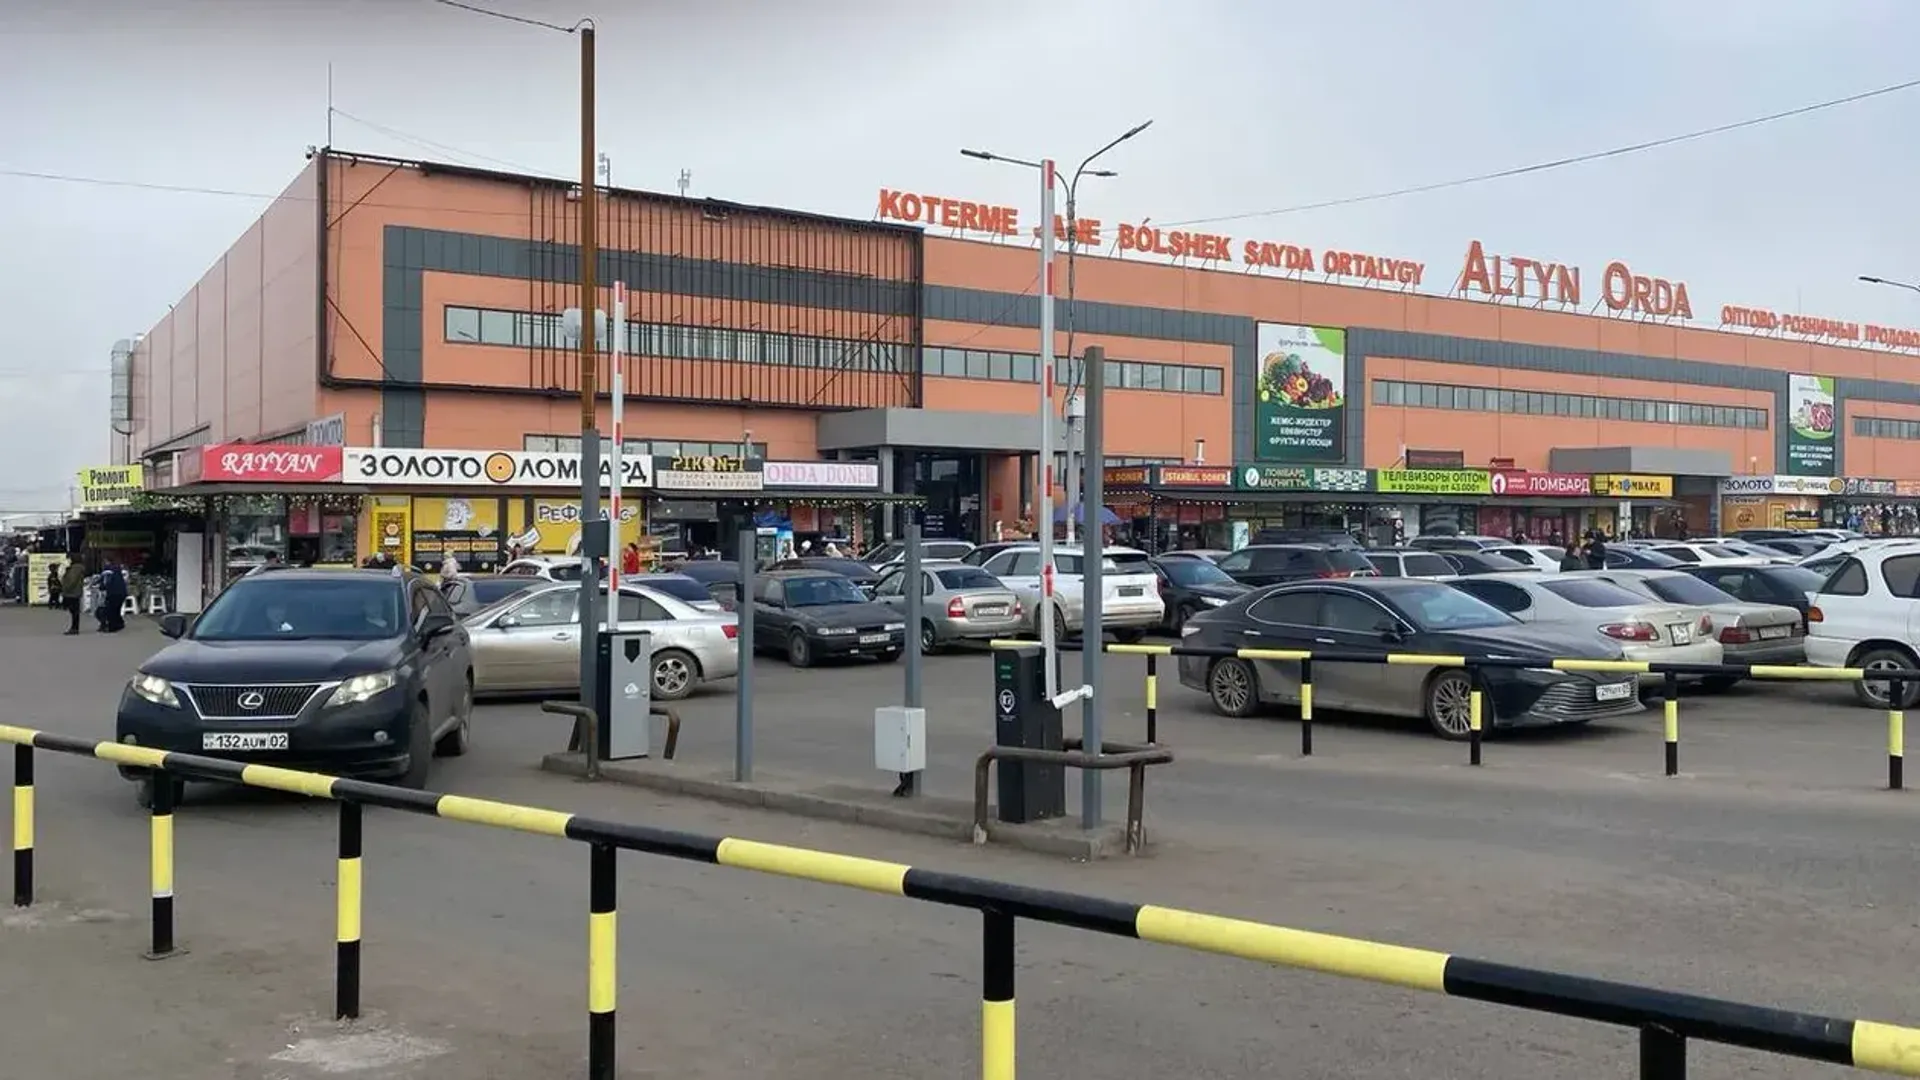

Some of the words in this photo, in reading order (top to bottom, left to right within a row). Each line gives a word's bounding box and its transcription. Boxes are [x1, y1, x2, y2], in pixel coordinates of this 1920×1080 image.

[880, 188, 1018, 236] KOTERME
[1118, 217, 1232, 261] BÓLSHEK
[1243, 240, 1315, 272] SAYDA
[1322, 250, 1425, 285] ORTALYGY
[1459, 240, 1580, 305] ALTYN
[1603, 261, 1693, 320] ORDA
[221, 451, 322, 475] RAYYAN
[360, 453, 482, 479] ЗОЛОТО
[519, 457, 647, 484] ЛОМАРД
[90, 469, 130, 485] Ремонт
[767, 465, 818, 482] ORDA
[1264, 467, 1306, 479] ЛОМБАРД
[1383, 470, 1450, 482] ТЕЛЕВИЗОРЫ
[1452, 472, 1487, 483] ОПТОМ
[1529, 476, 1590, 493] ЛОМБАРД
[1725, 480, 1772, 490] ЗОЛОТО
[270, 735, 288, 747] 02
